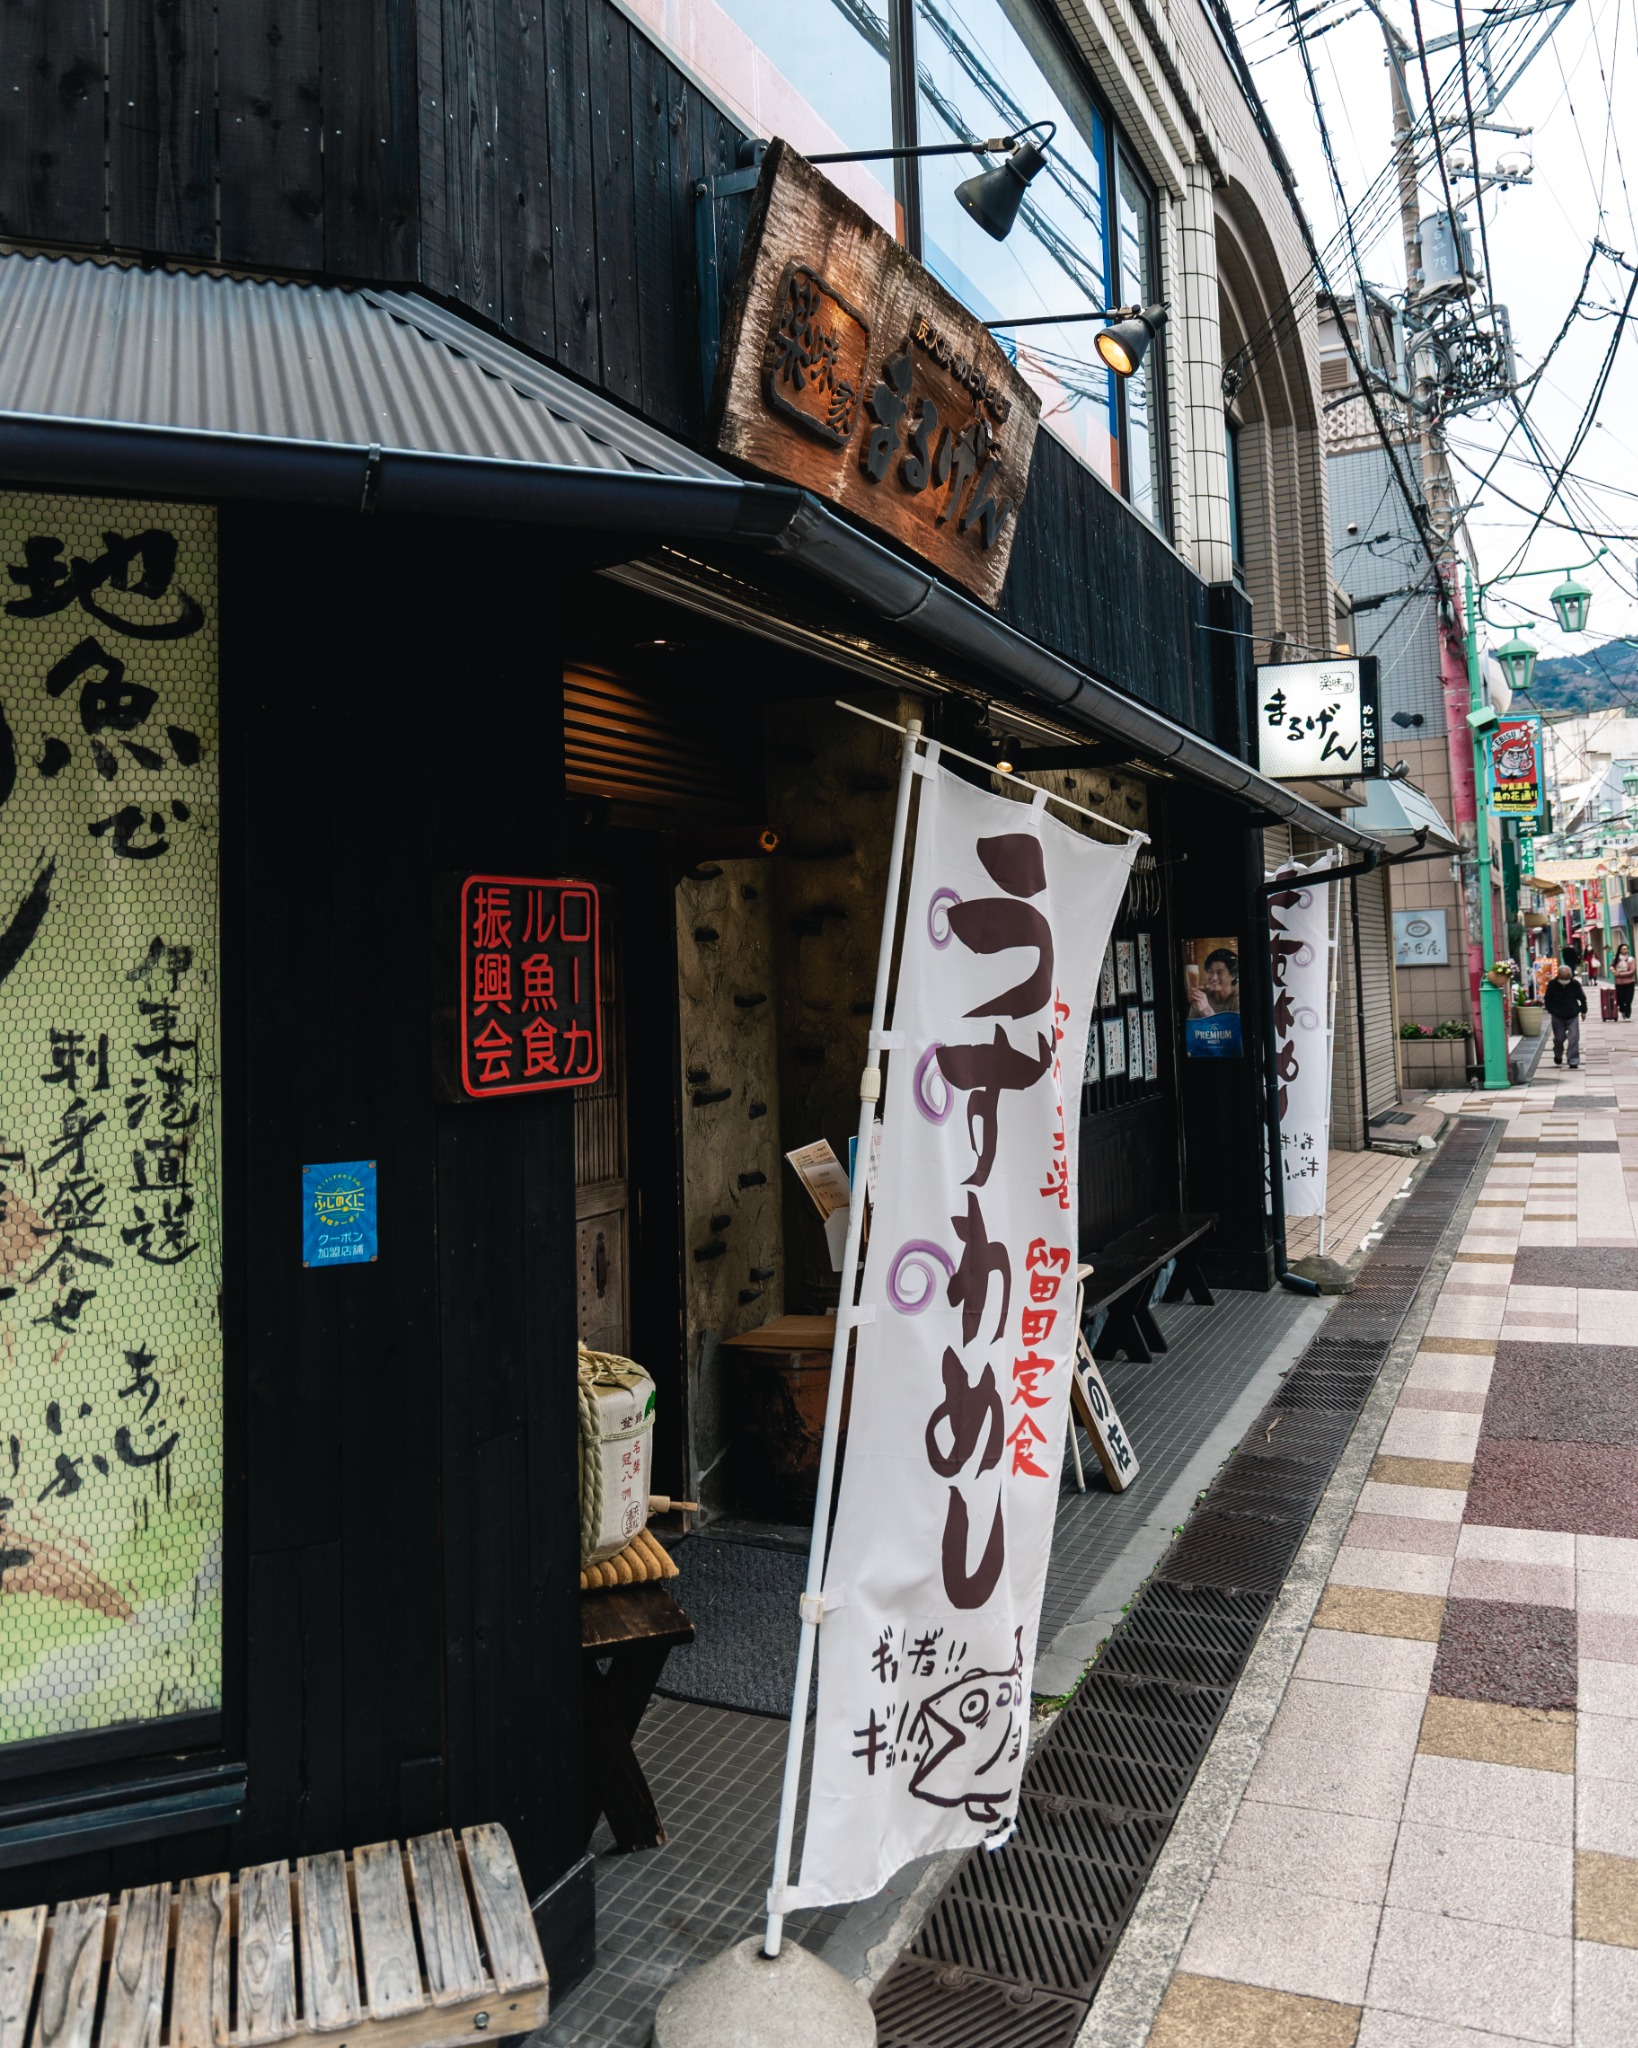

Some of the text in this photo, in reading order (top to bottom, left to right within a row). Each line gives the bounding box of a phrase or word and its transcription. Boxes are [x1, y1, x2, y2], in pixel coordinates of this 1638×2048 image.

[864, 337, 1013, 549] まるげん
[1264, 688, 1358, 761] まるげん
[1362, 705, 1376, 767] めし処・地酒
[1495, 731, 1517, 746] EBISU
[1194, 1029, 1232, 1040] PREMIUM
[314, 1193, 365, 1211] ふじのくに
[318, 1232, 363, 1246] クーポン
[318, 1244, 364, 1259] 加盟店舗
[114, 1341, 181, 1468] あじ
